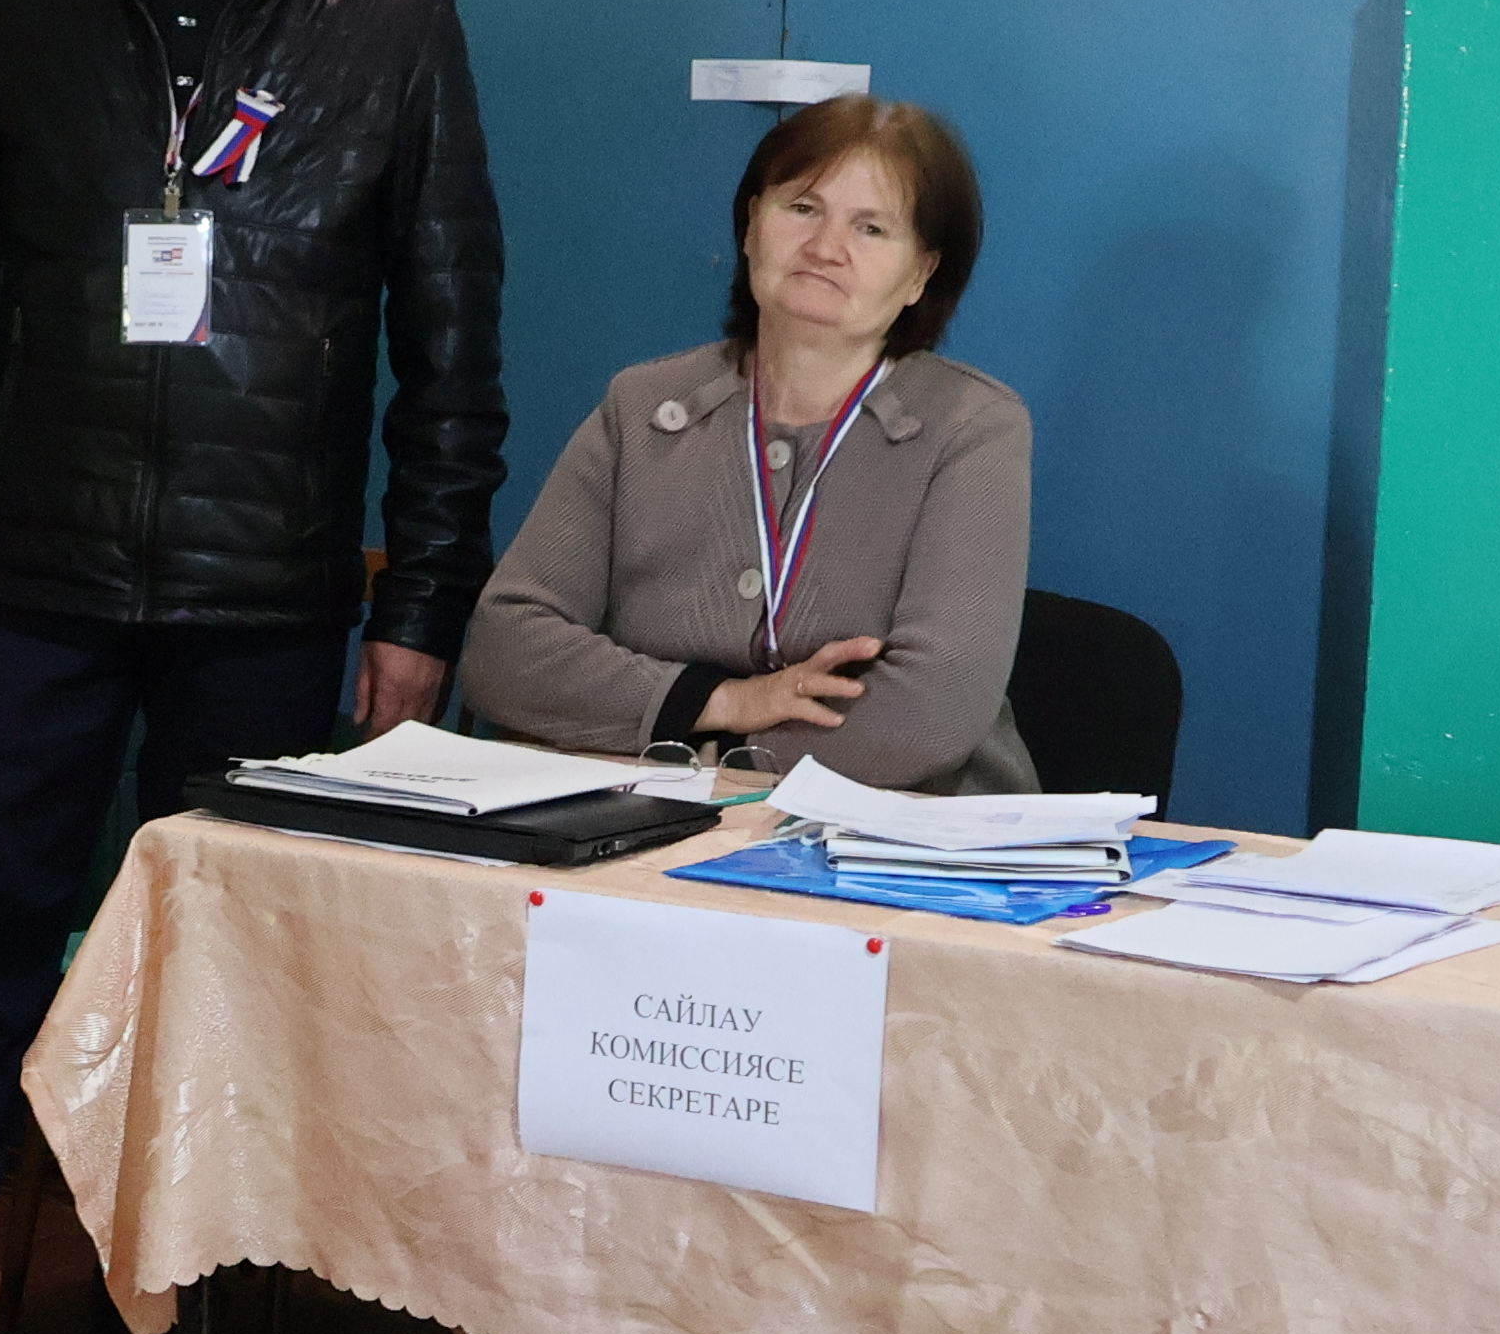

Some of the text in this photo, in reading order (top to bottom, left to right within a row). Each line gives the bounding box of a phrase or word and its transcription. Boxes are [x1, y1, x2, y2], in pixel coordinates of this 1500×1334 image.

[633, 993, 763, 1034] САЙЛАУ
[589, 1031, 805, 1085] КОМИССИЯСЕ
[607, 1078, 781, 1126] СЕКРЕТАРЕ
